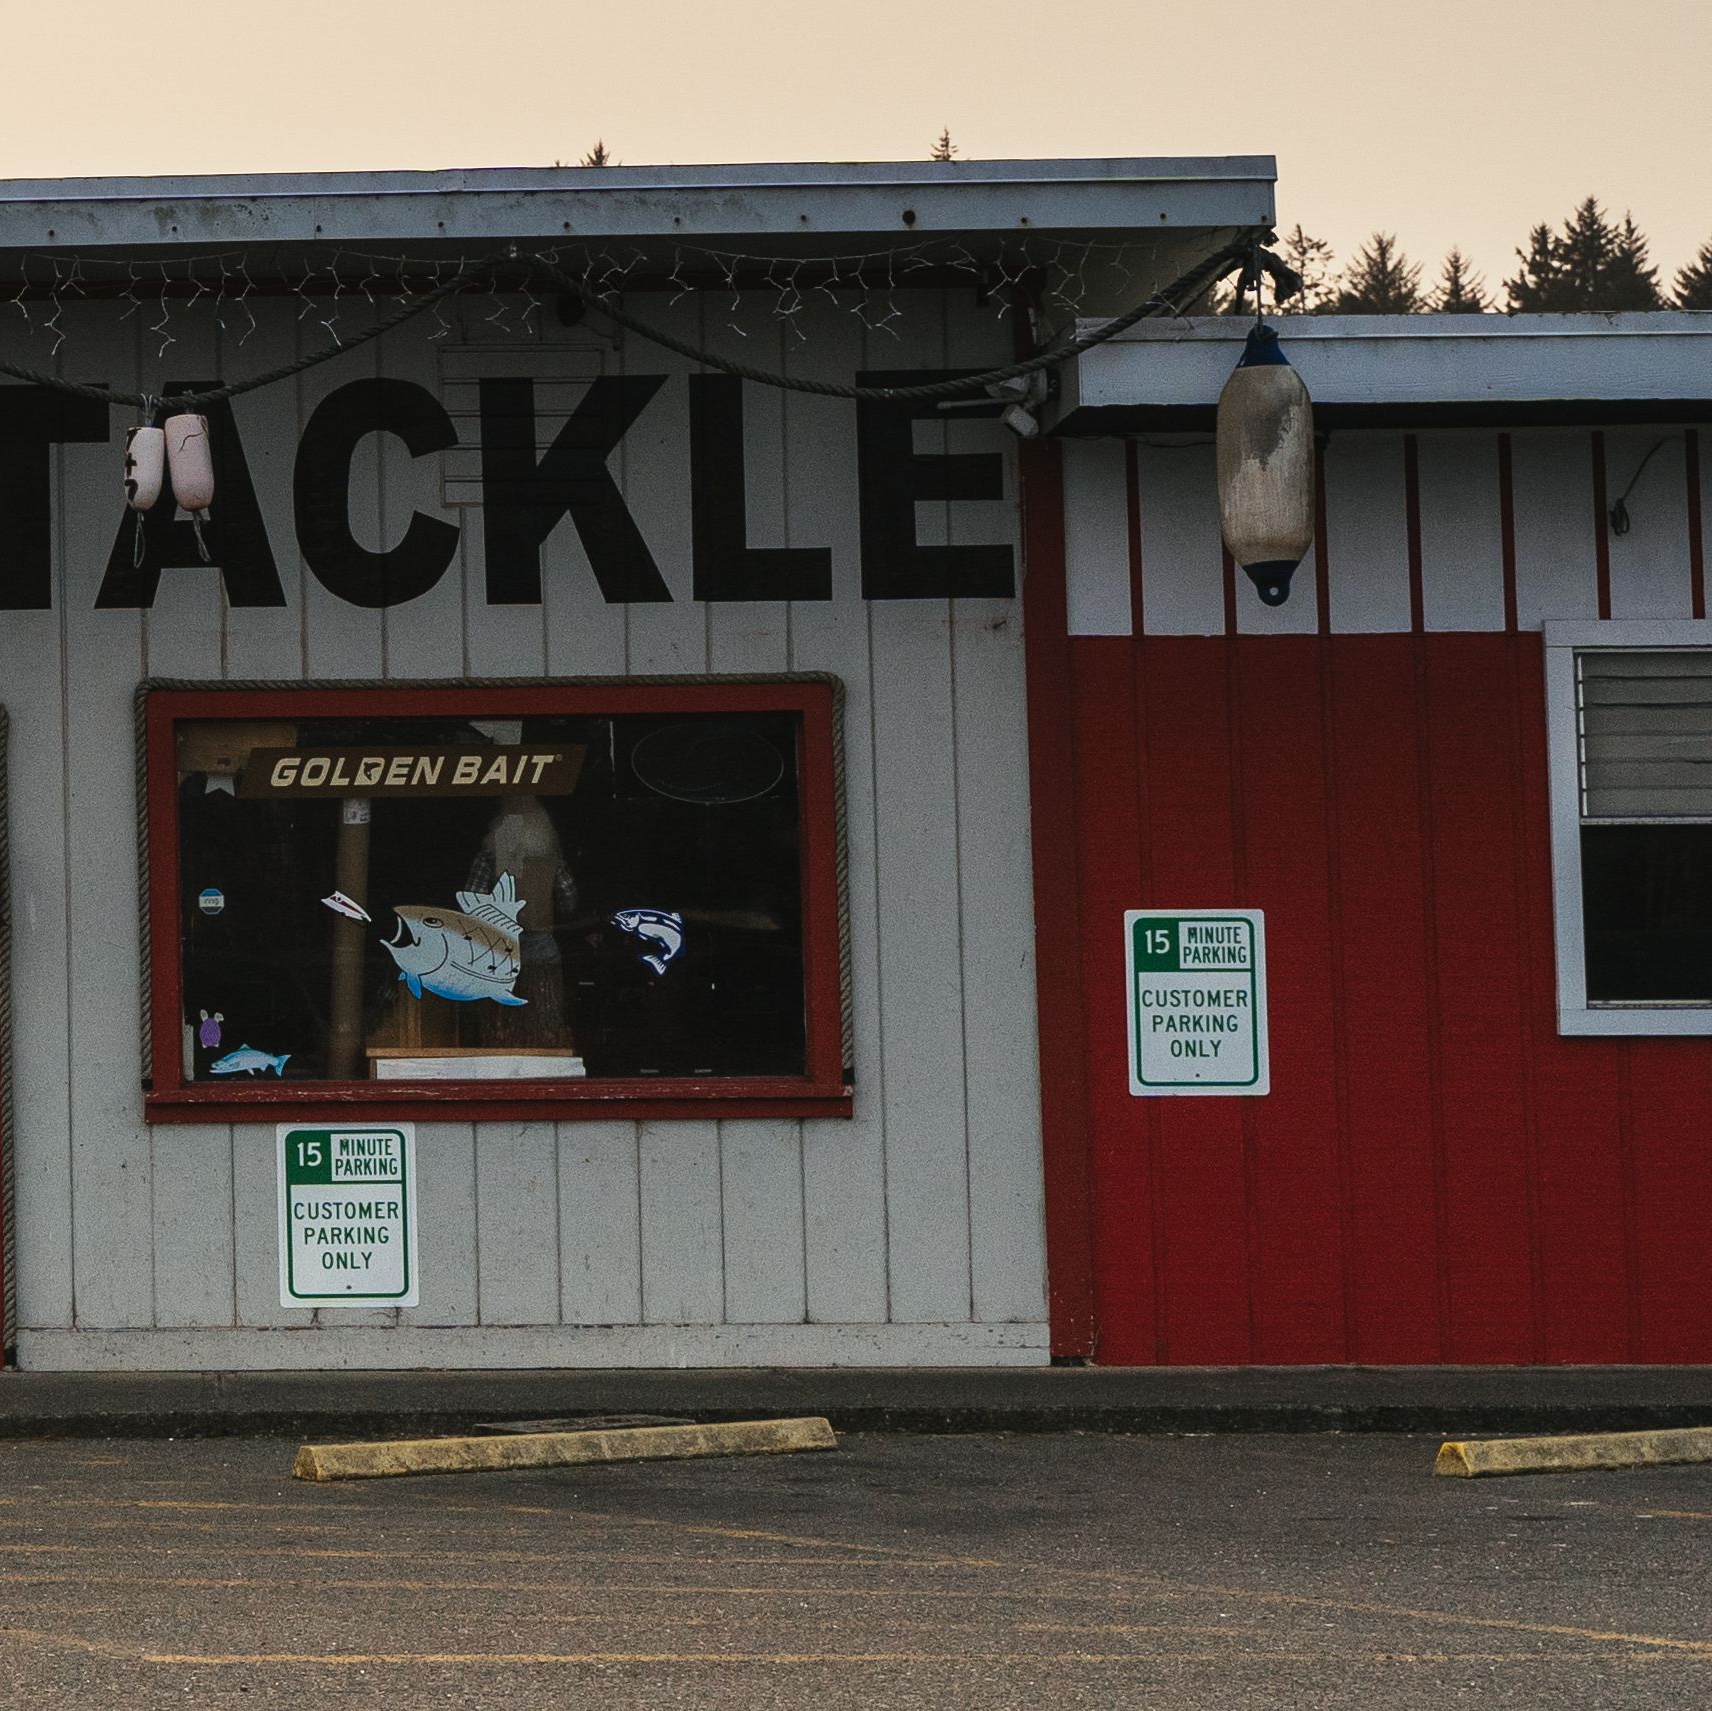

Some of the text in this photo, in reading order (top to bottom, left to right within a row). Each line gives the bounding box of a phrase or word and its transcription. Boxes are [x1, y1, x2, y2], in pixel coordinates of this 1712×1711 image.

[270, 755, 555, 787] GOLDEN BAIT
[1145, 930, 1170, 954] 15
[1188, 927, 1241, 944] MINUTE
[1183, 946, 1247, 964] PARKING
[1142, 990, 1248, 1007] CUSTOMER
[1152, 1015, 1238, 1032] PARKING
[1171, 1040, 1221, 1057] ONLY
[297, 1142, 322, 1167] 15
[339, 1139, 393, 1156] MINUTE
[335, 1158, 398, 1176] PARKING
[294, 1202, 399, 1220] CUSTOMER
[304, 1226, 389, 1245] PARKING
[322, 1252, 372, 1269] ONLY
